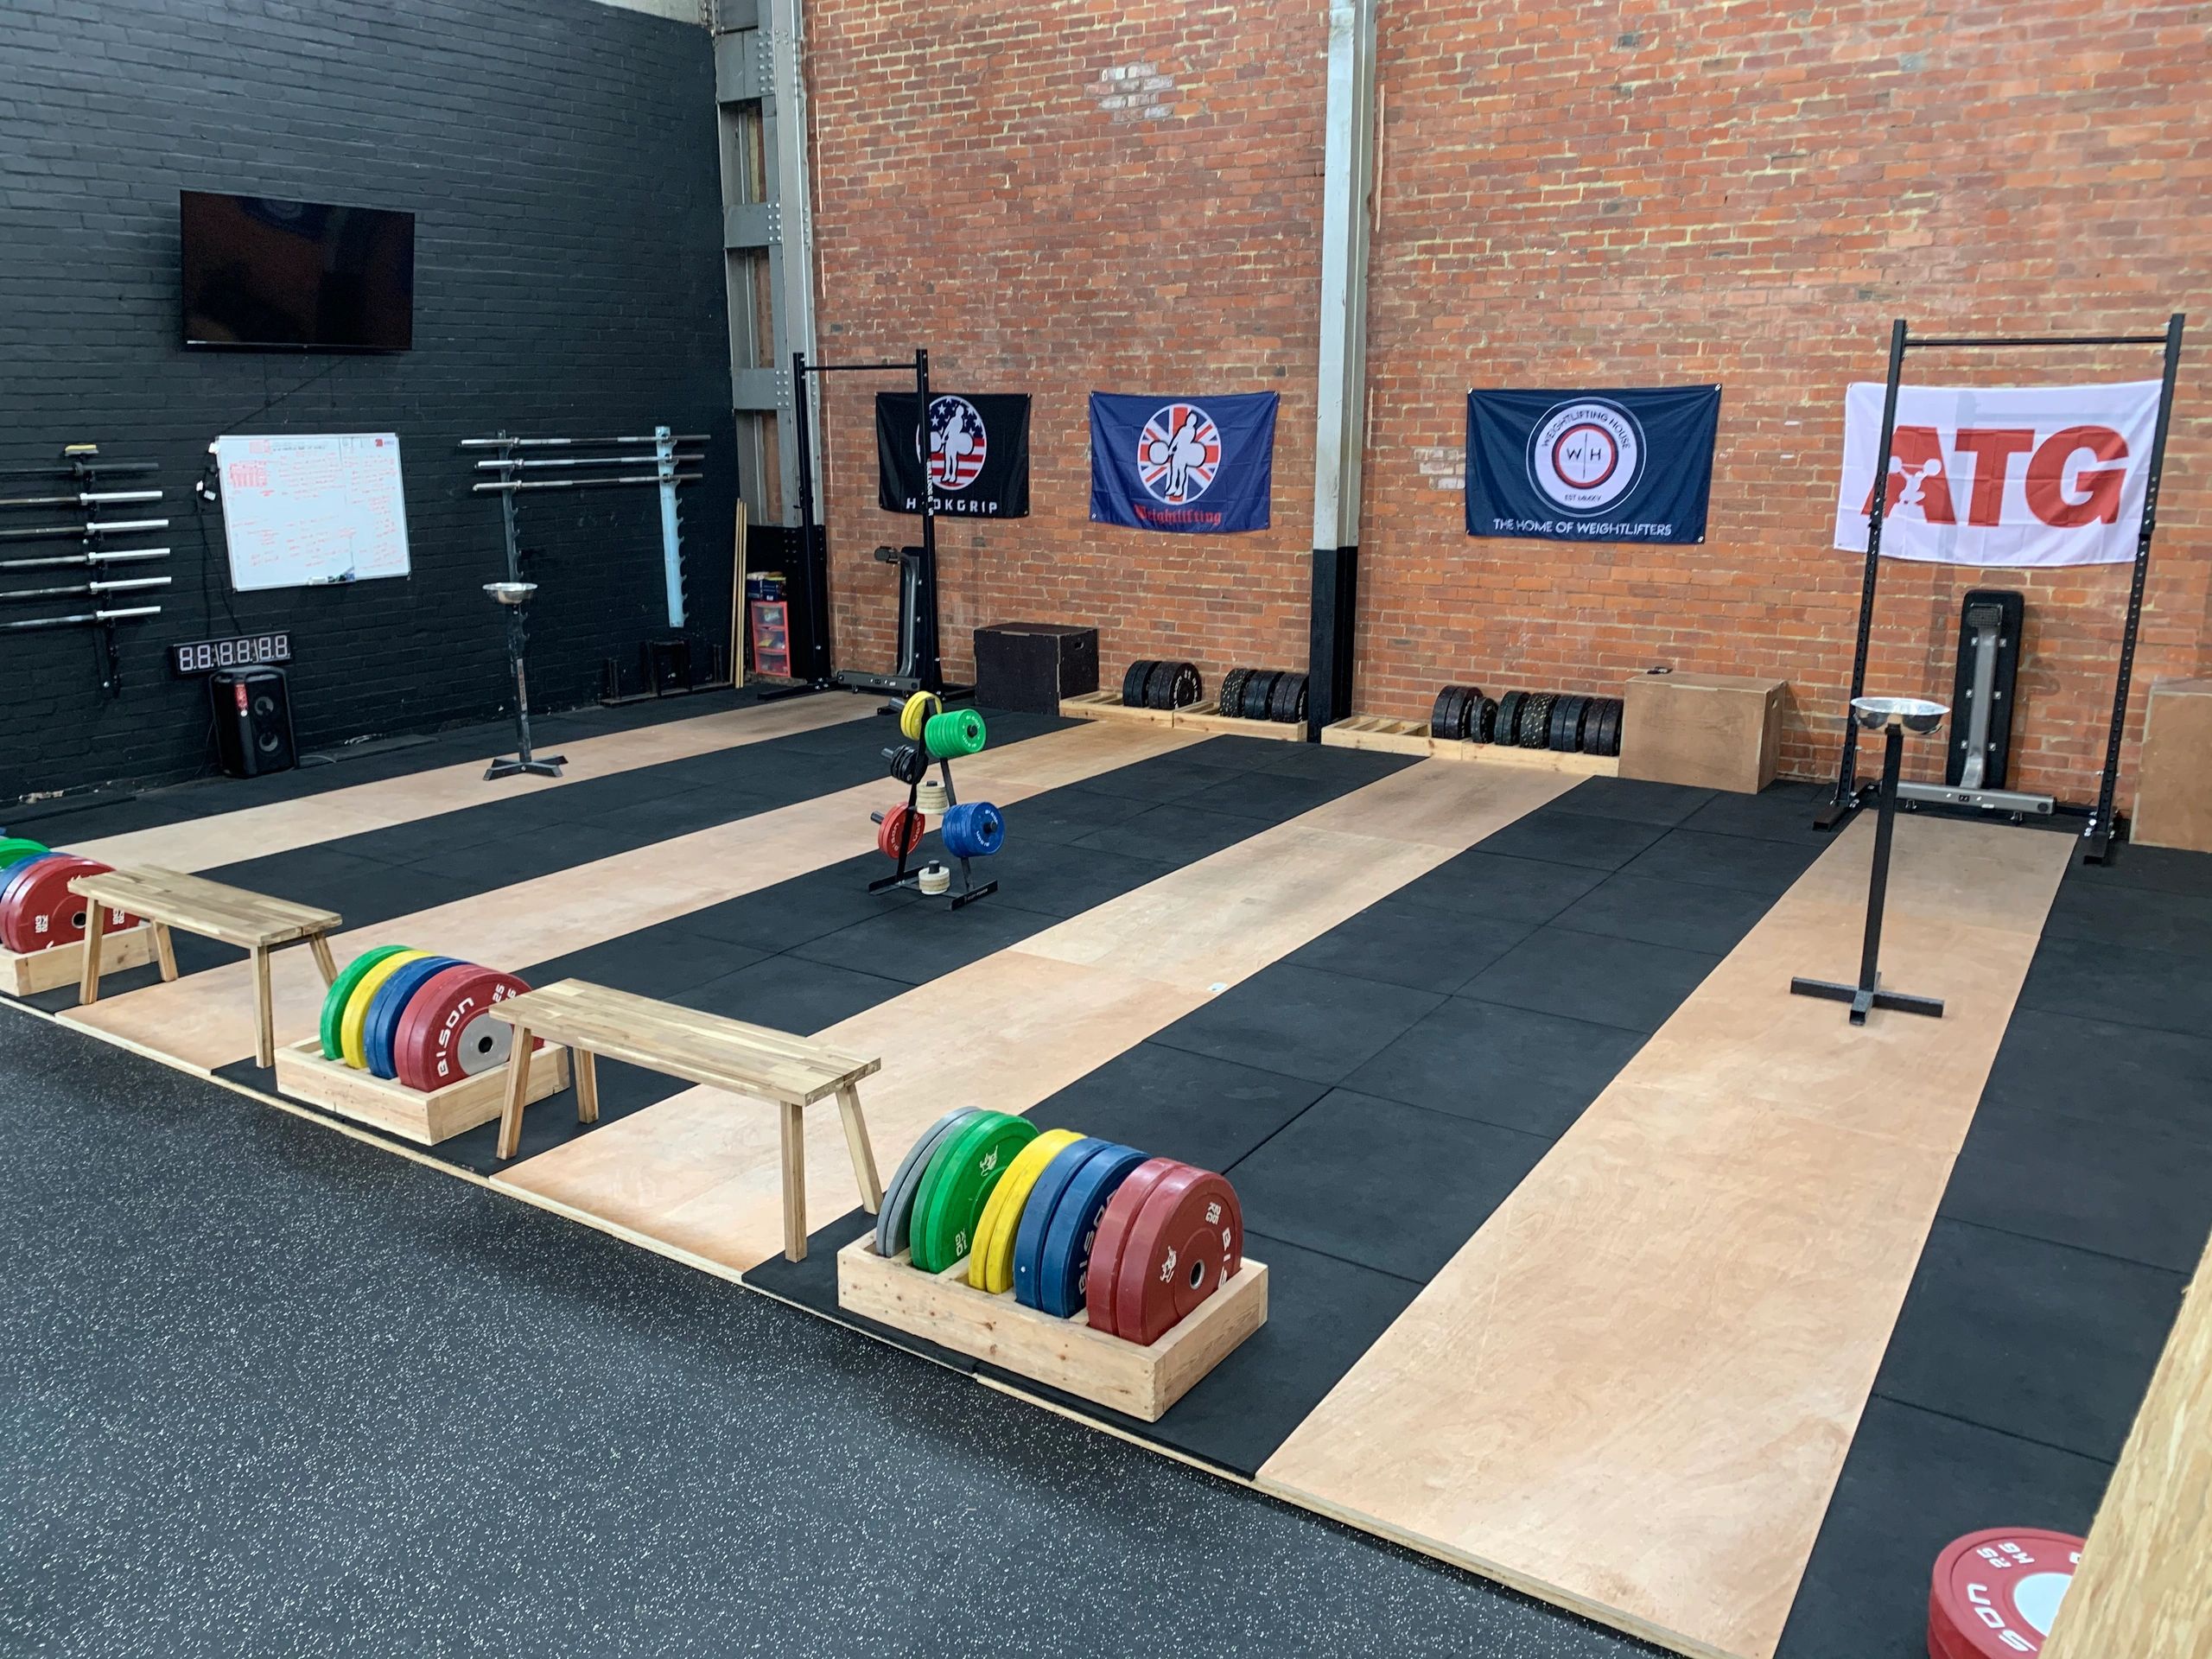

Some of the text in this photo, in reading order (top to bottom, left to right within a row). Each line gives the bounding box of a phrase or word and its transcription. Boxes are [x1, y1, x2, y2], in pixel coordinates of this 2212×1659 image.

[1541, 410, 1631, 450] WEIGHTLIFTING HOUSE
[1861, 425, 2129, 528] ATG
[906, 497, 998, 514] HOKGRIP
[1493, 518, 1673, 537] THE HOME OF WEIGHTLIFTERS
[493, 983, 505, 1002] 25
[435, 997, 474, 1077] BISON
[1218, 1227, 1231, 1289] BIS
[1977, 1548, 2012, 1568] 25
[1999, 1542, 2035, 1564] KG
[1967, 1583, 2037, 1652] SON
